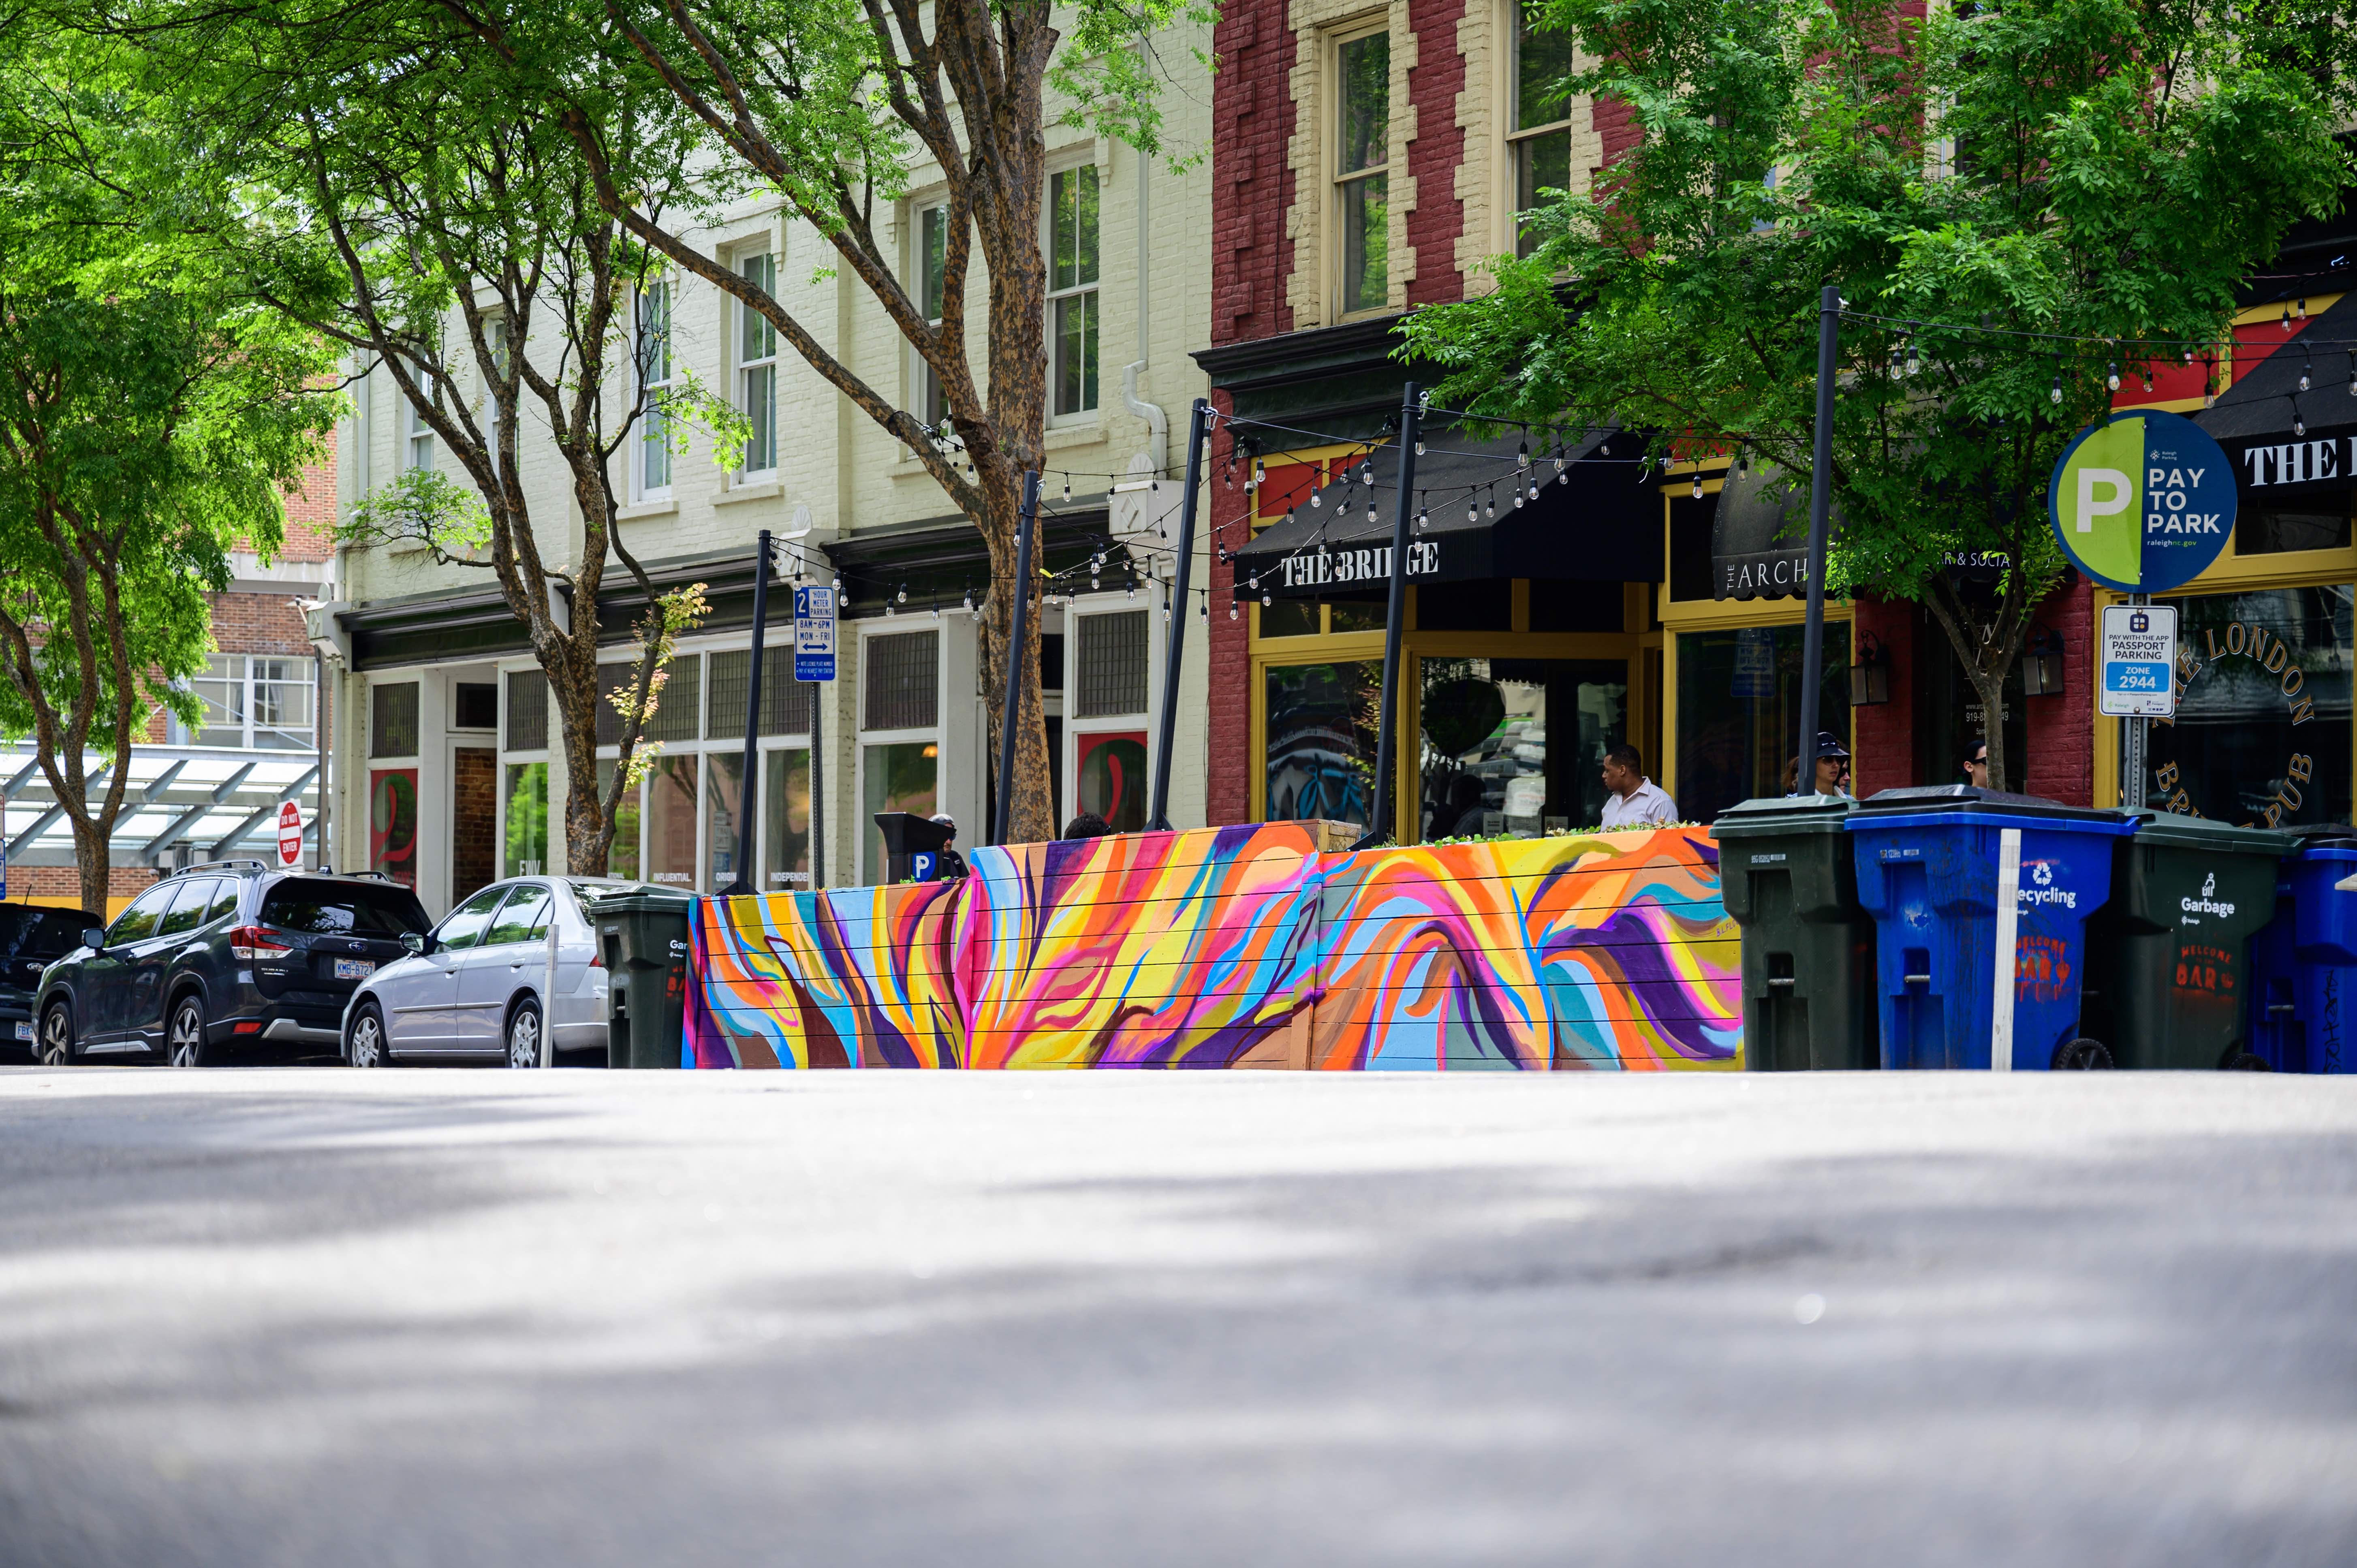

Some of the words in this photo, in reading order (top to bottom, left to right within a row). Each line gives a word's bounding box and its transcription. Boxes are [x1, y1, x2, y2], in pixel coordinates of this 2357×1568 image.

[2245, 438, 2337, 486] THE
[2149, 469, 2205, 487] PAY
[2077, 468, 2132, 532] P
[2149, 491, 2186, 511] TO
[2148, 514, 2220, 533] PARK
[2148, 539, 2197, 547] raleighnc.gov
[1970, 552, 2010, 567] SOCIA
[1281, 554, 1332, 587] THE
[1737, 558, 1808, 588] ARCH
[798, 593, 806, 613] 2
[800, 632, 813, 640] MON
[821, 632, 830, 640] FRI
[2112, 641, 2165, 650] PASSPORT
[2115, 651, 2162, 660] PARKING
[2119, 675, 2156, 689] 2944
[2205, 622, 2314, 726] LONDON
[281, 815, 288, 826] DO
[288, 813, 297, 824] NOT
[283, 841, 297, 853] ENTER
[916, 855, 929, 878] P
[716, 872, 737, 882] ORIGIN
[2018, 887, 2076, 908] ecycling
[2182, 897, 2235, 918] Garbage
[670, 940, 688, 950] Gar
[2181, 944, 2232, 964] WELCOME
[338, 963, 373, 976] KMB-8727
[2176, 963, 2216, 990] BAR
